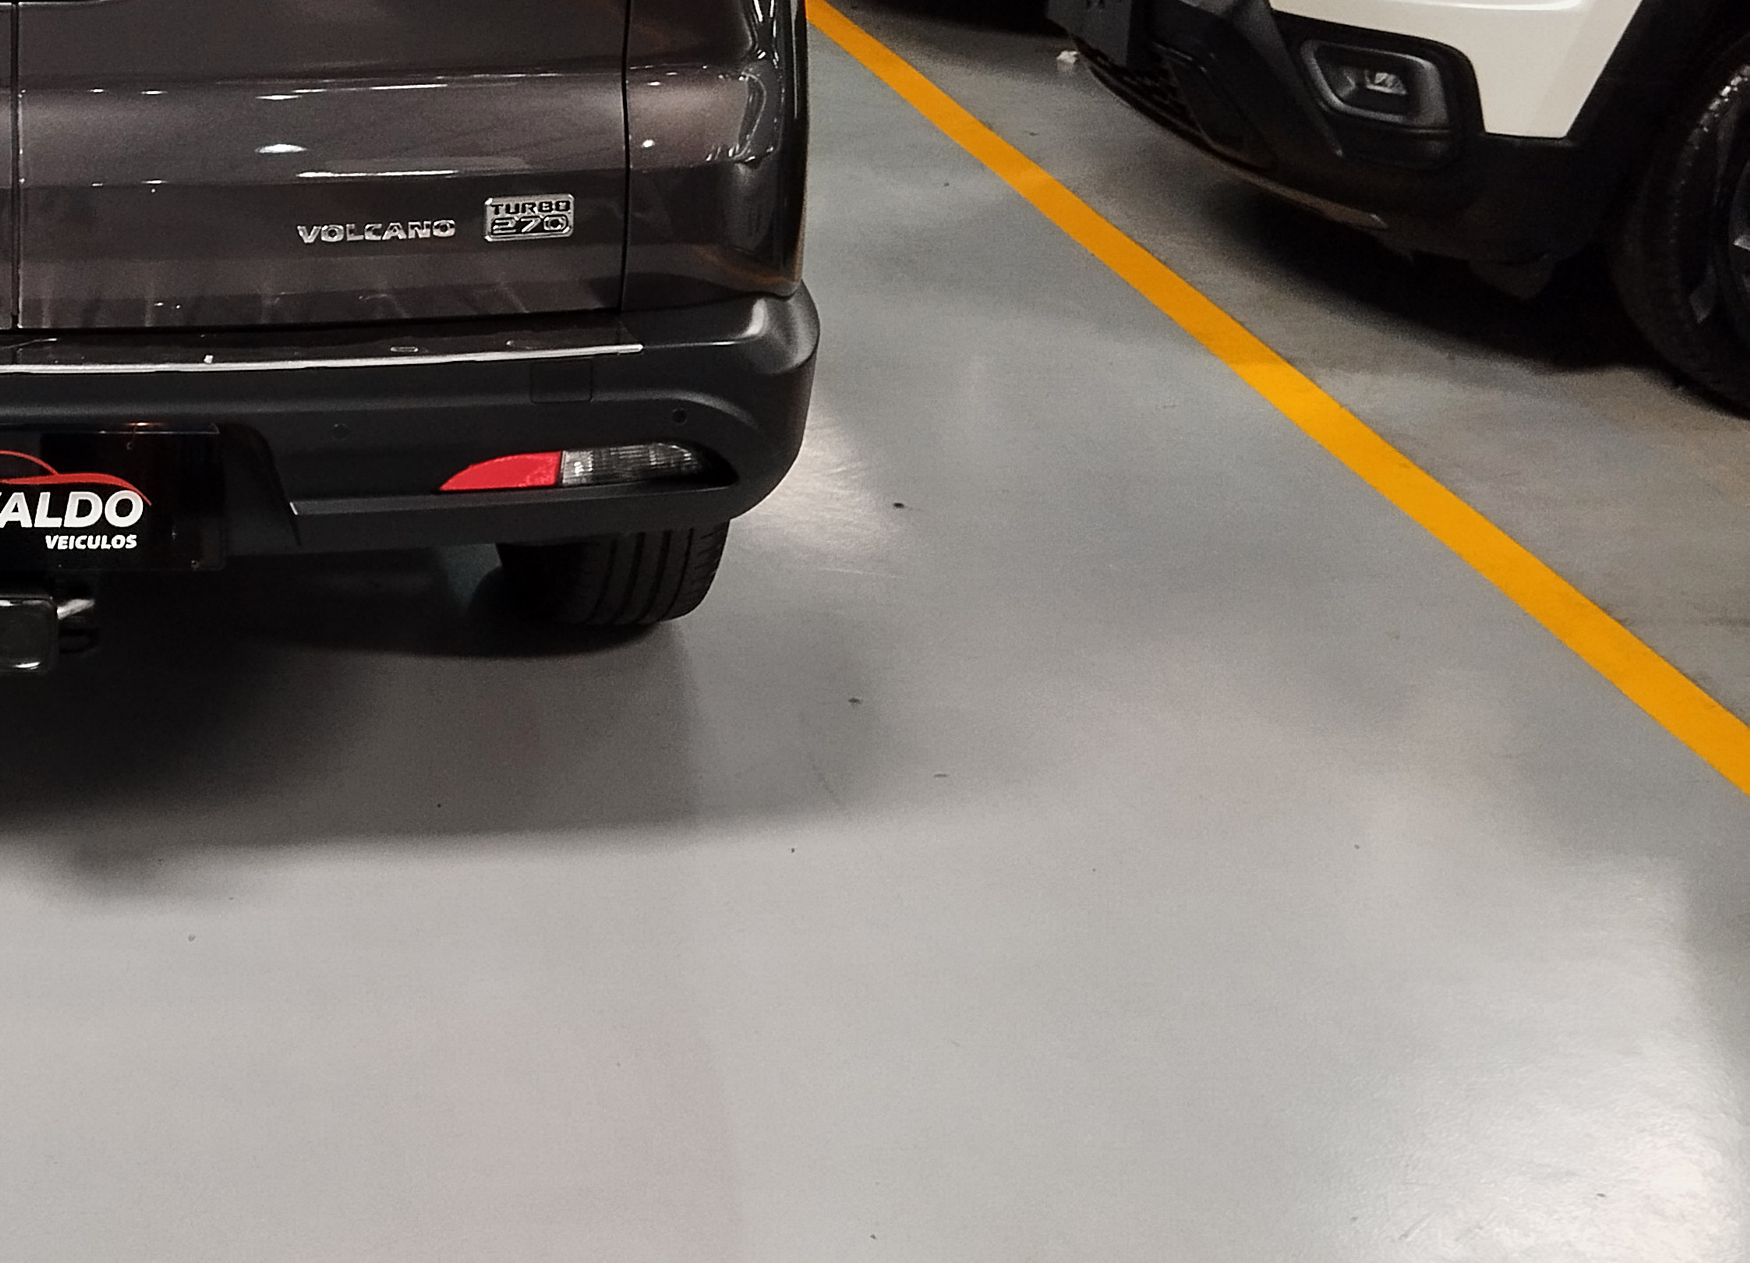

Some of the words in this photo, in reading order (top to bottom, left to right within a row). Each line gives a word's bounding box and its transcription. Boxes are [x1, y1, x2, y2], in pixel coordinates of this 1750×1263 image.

[491, 200, 571, 216] TURBO
[297, 219, 456, 244] VOLCANO
[492, 215, 571, 235] 270
[45, 534, 138, 550] VEICULOS
